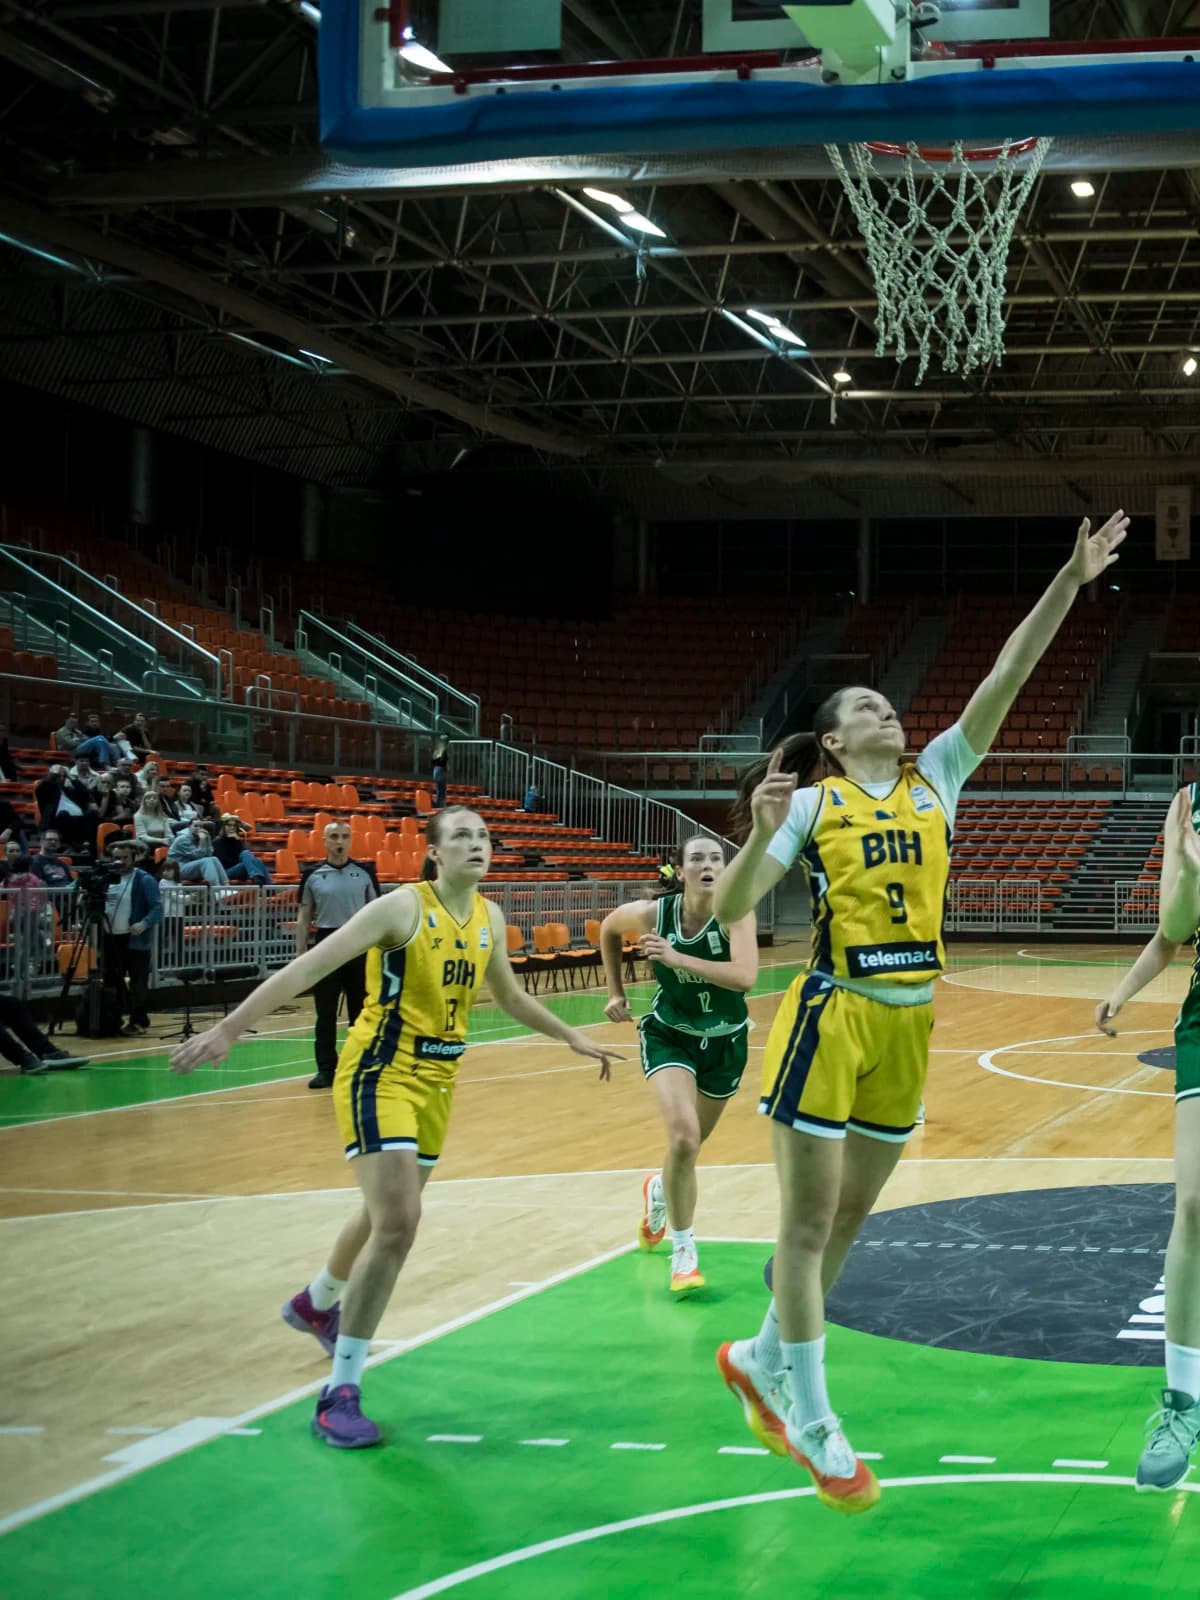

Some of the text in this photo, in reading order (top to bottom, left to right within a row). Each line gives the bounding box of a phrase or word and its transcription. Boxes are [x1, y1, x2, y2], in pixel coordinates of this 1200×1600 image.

[861, 829, 923, 869] BIH
[886, 882, 908, 924] 9
[442, 959, 476, 989] BIH
[857, 950, 936, 968] telemac
[444, 998, 458, 1031] 13
[697, 991, 713, 1013] 12
